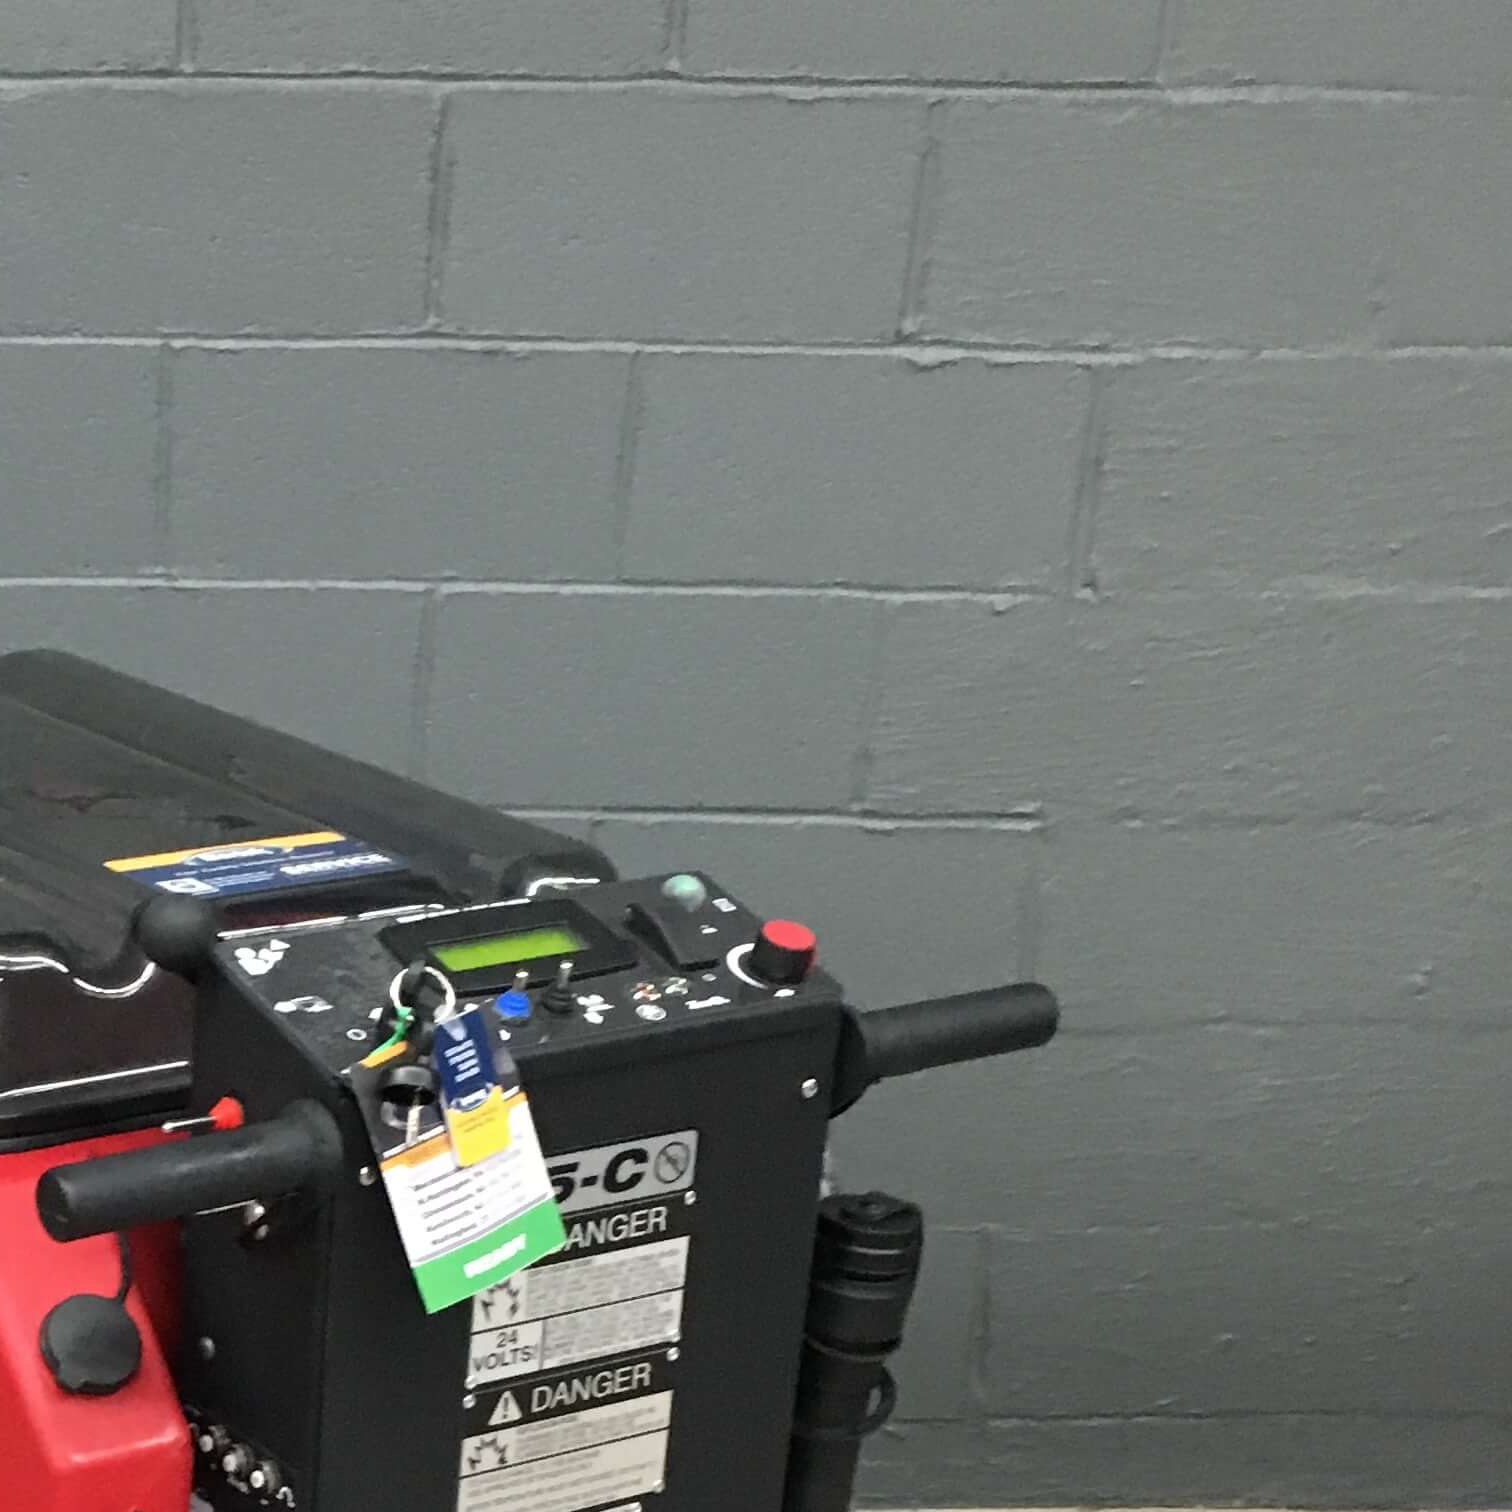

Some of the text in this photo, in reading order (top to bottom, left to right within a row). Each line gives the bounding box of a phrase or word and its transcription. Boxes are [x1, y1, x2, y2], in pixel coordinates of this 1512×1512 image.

[564, 1206, 668, 1252] ANGER
[496, 1329, 519, 1349] 24
[530, 1362, 652, 1414] DANGER
